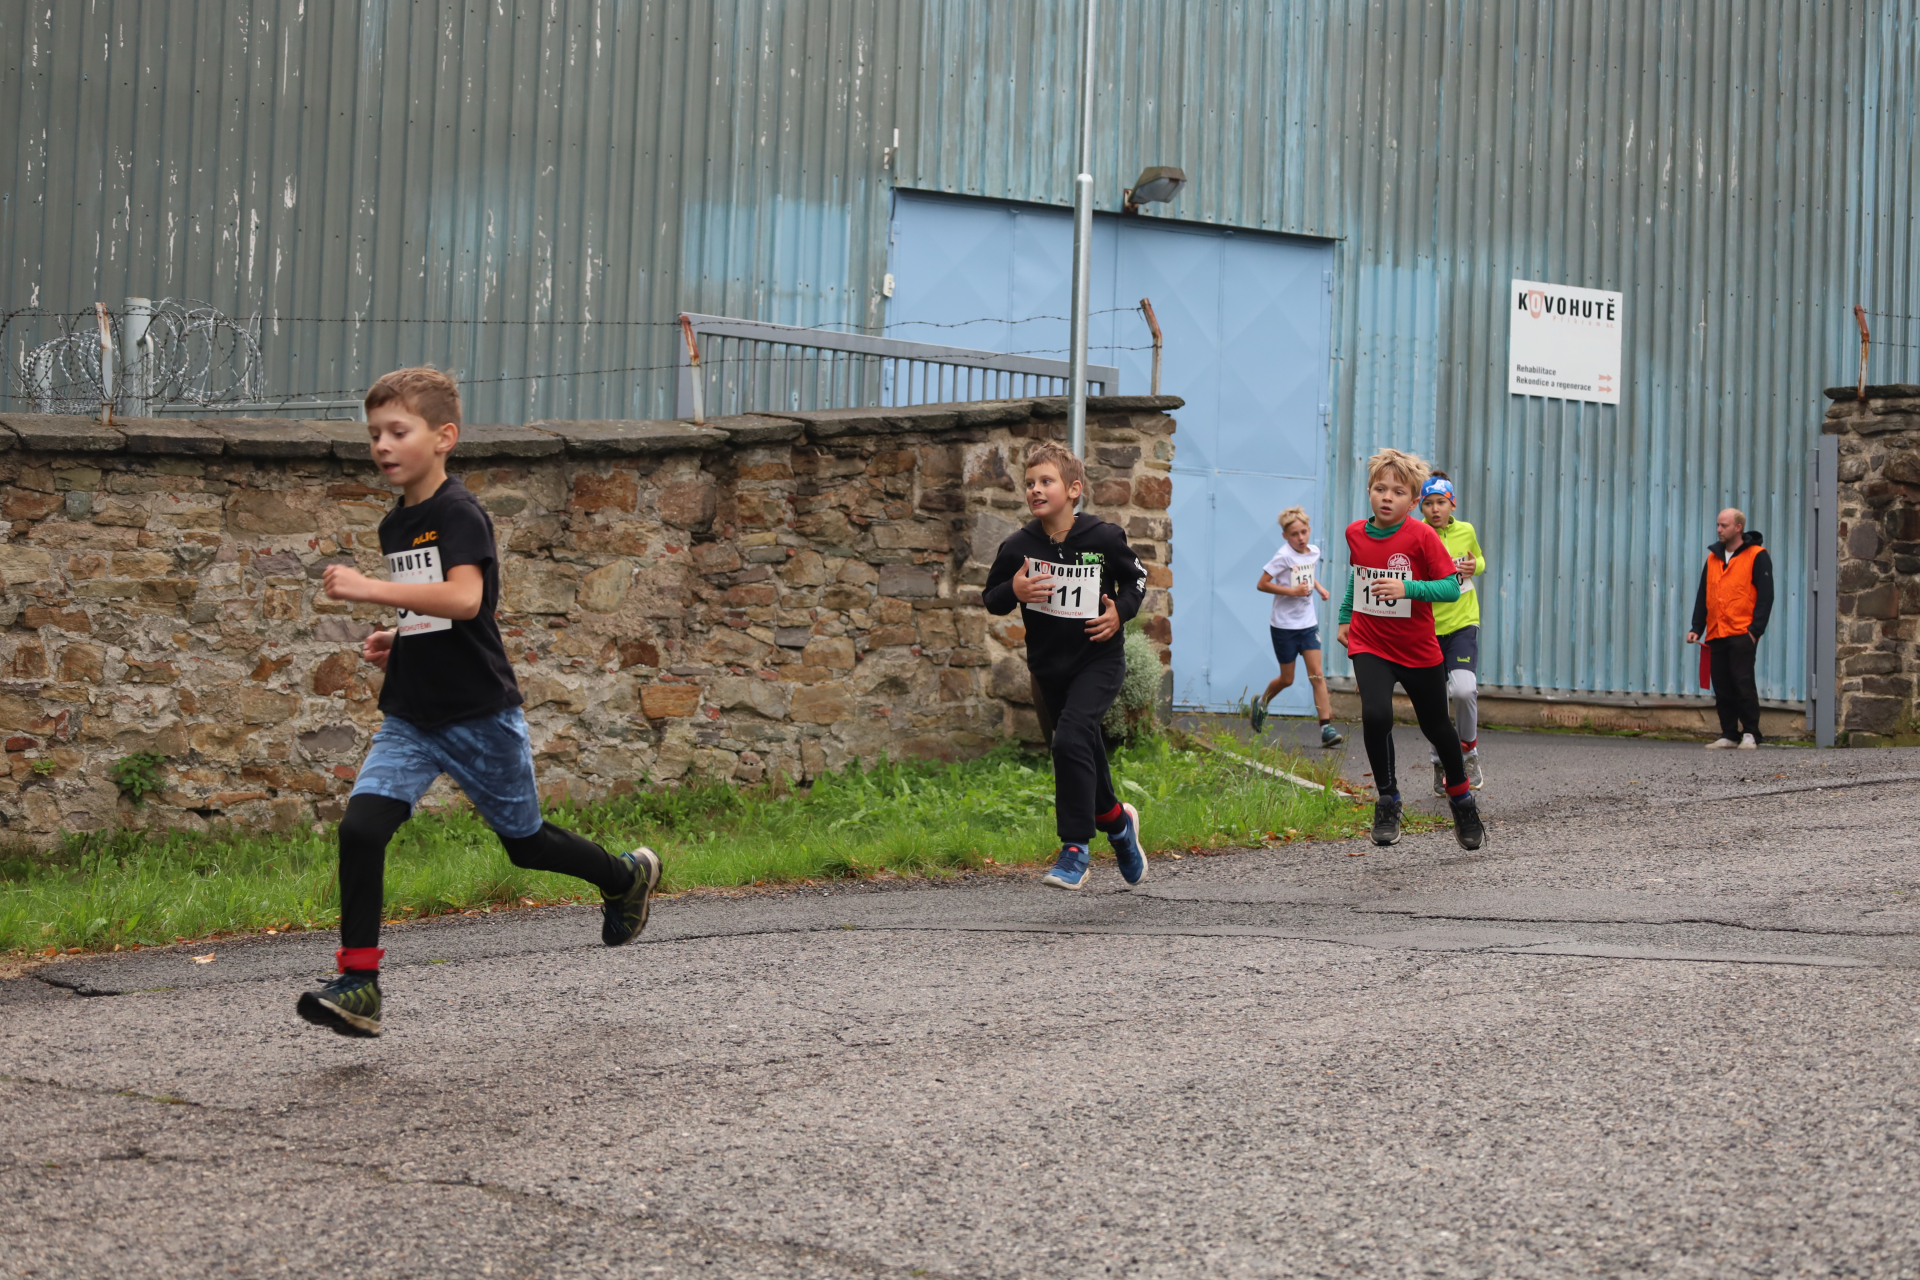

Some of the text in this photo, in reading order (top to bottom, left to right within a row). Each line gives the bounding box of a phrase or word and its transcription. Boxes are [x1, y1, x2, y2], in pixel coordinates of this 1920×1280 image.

[1518, 290, 1615, 321] KOVOHUTĚ
[1516, 364, 1557, 376] Rehabilitace
[1516, 376, 1549, 387] Rekondice
[1556, 382, 1592, 392] regenerace
[391, 550, 432, 573] OHUTĚ
